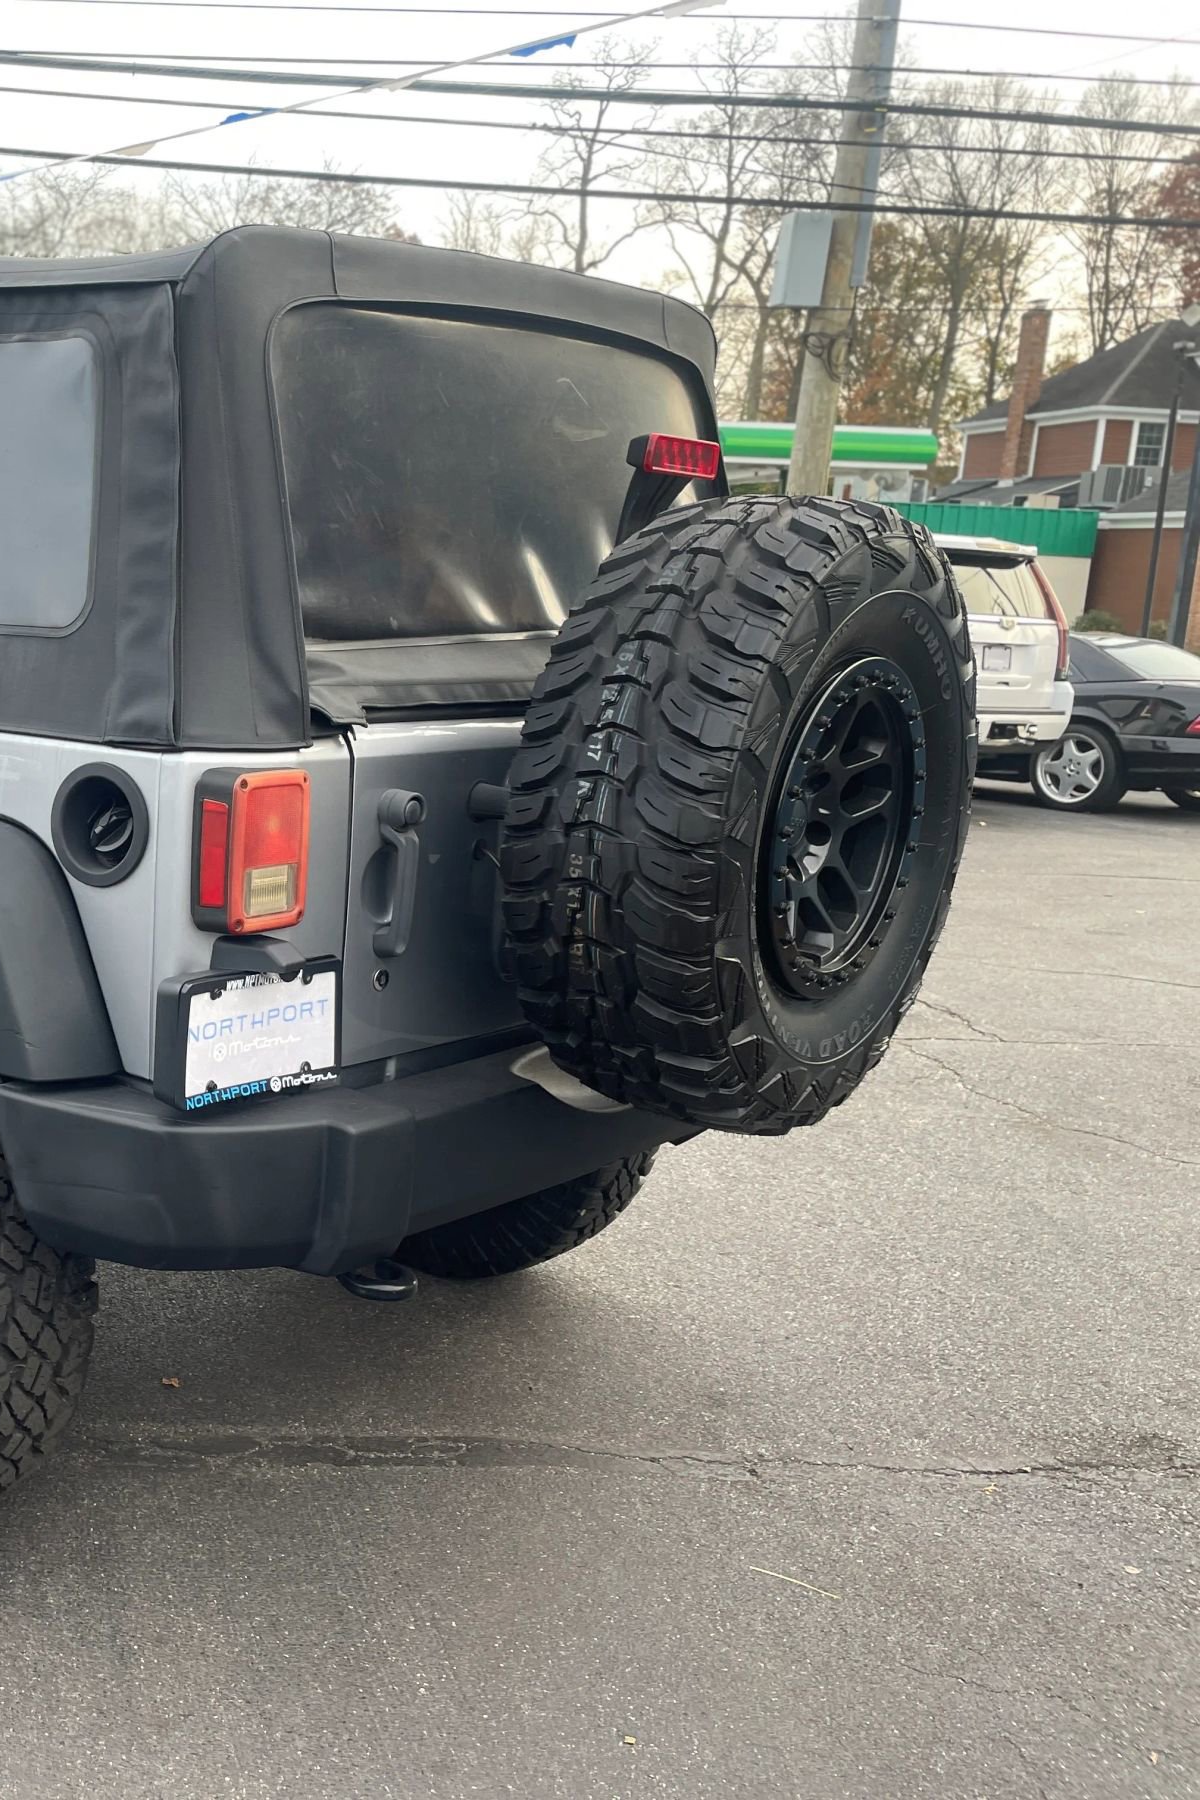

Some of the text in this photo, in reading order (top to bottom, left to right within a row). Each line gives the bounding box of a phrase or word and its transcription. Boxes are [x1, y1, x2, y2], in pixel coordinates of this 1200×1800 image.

[902, 607, 952, 700] KUMHO
[188, 999, 329, 1043] NORTHPORT
[186, 1080, 268, 1111] NORTHPORT
